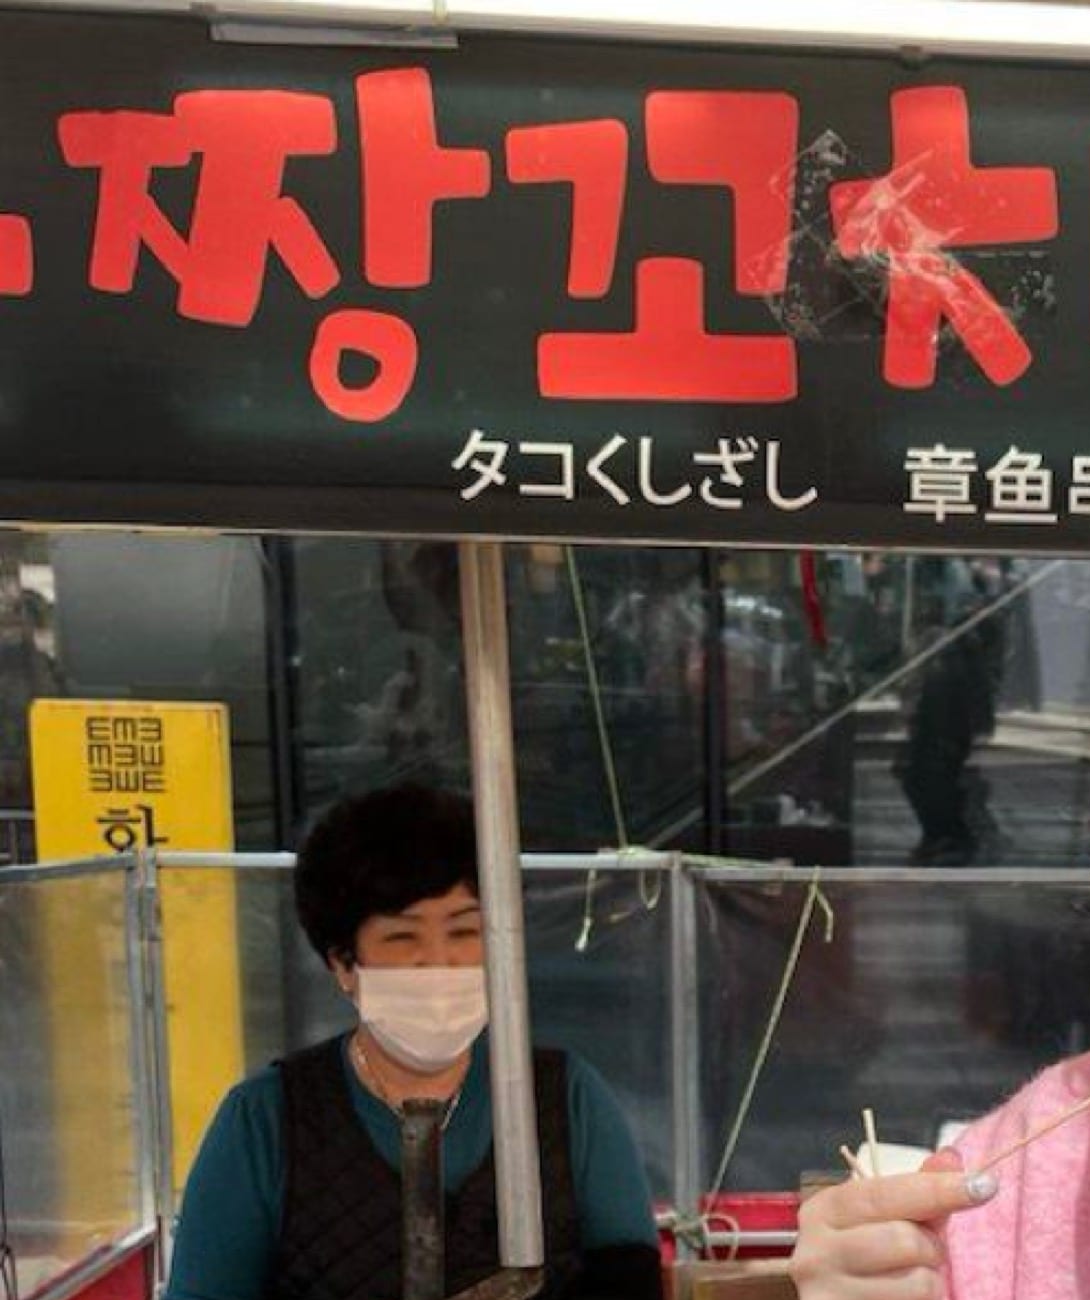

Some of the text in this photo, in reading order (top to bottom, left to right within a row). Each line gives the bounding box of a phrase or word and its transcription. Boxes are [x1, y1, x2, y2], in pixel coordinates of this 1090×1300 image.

[450, 428, 818, 509] タコくしざし
